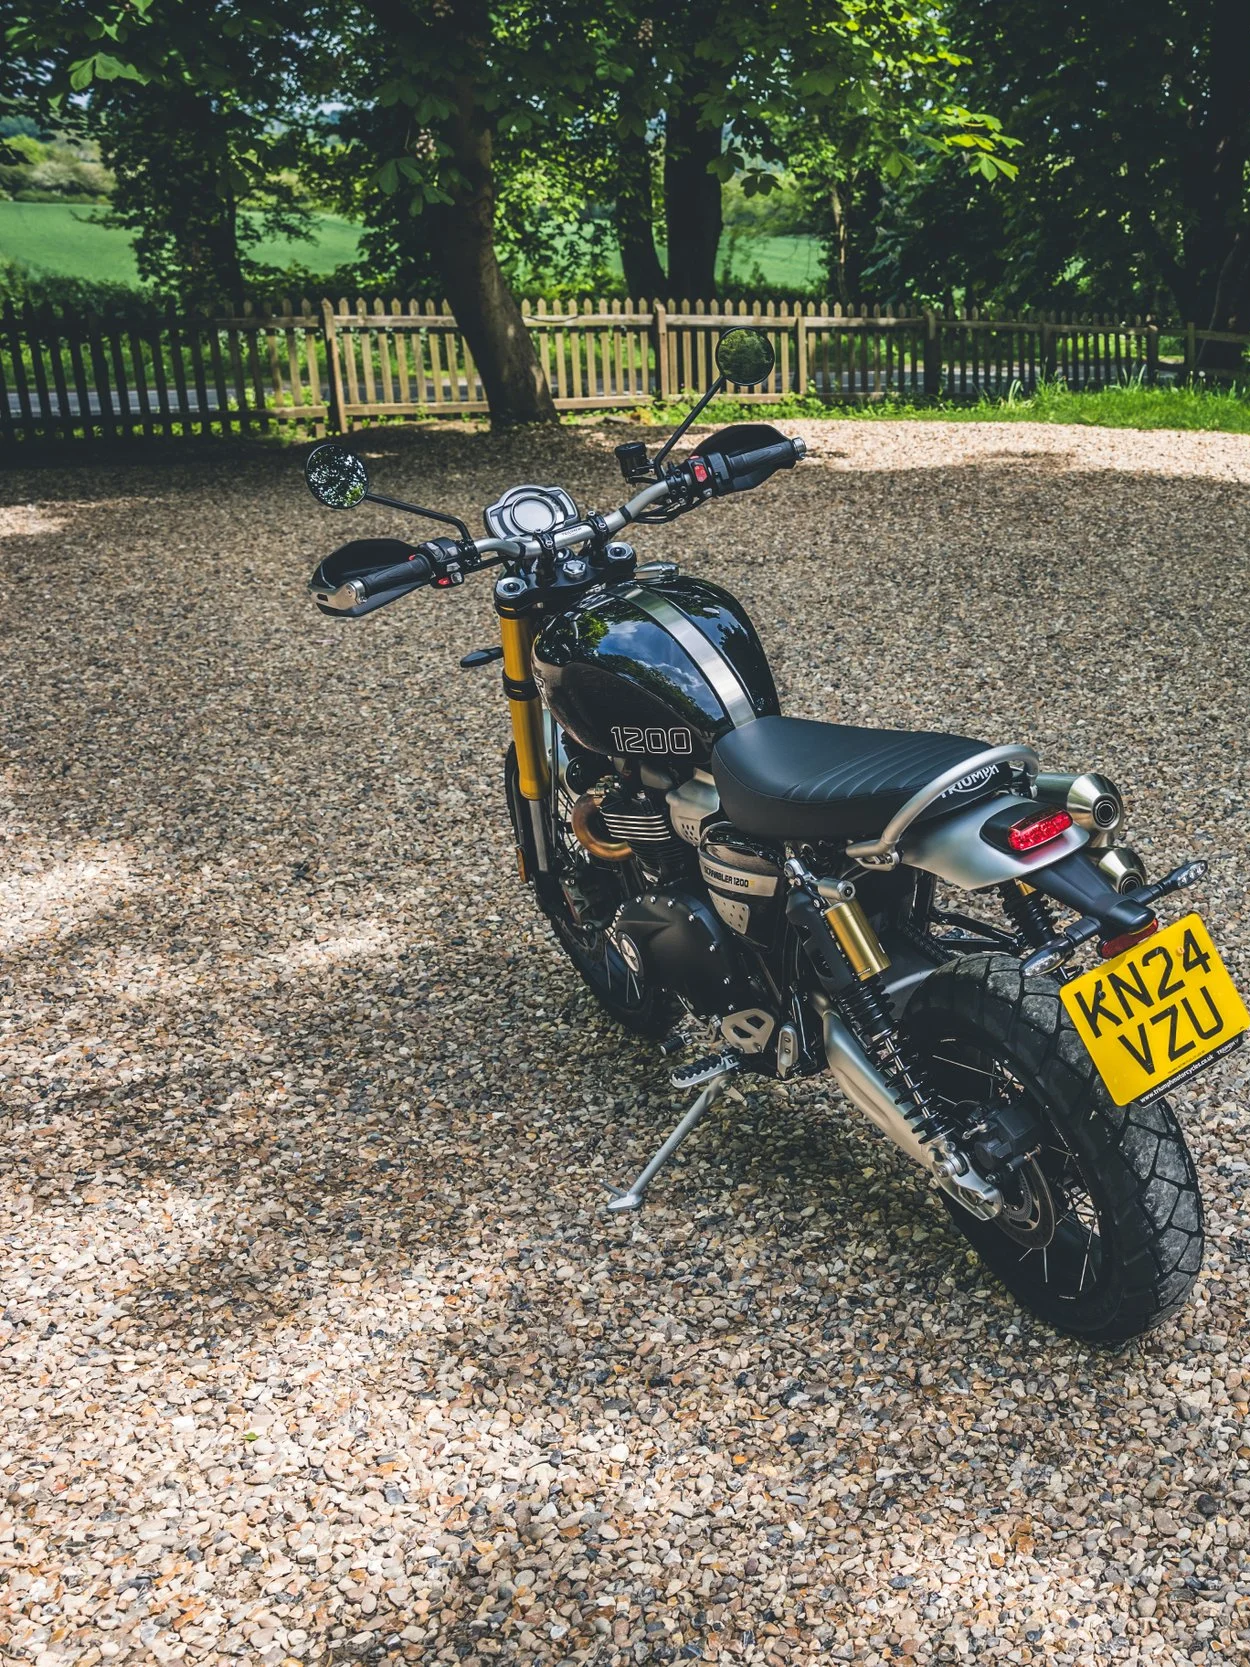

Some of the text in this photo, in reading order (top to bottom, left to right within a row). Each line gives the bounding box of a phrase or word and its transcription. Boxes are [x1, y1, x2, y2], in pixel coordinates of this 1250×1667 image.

[610, 726, 693, 754] 1200
[733, 876, 749, 888] 1200
[1074, 928, 1211, 1039] KN24
[1117, 986, 1224, 1076] VZU
[1139, 1054, 1215, 1103] www.triumphmotorcycles.co.uk
